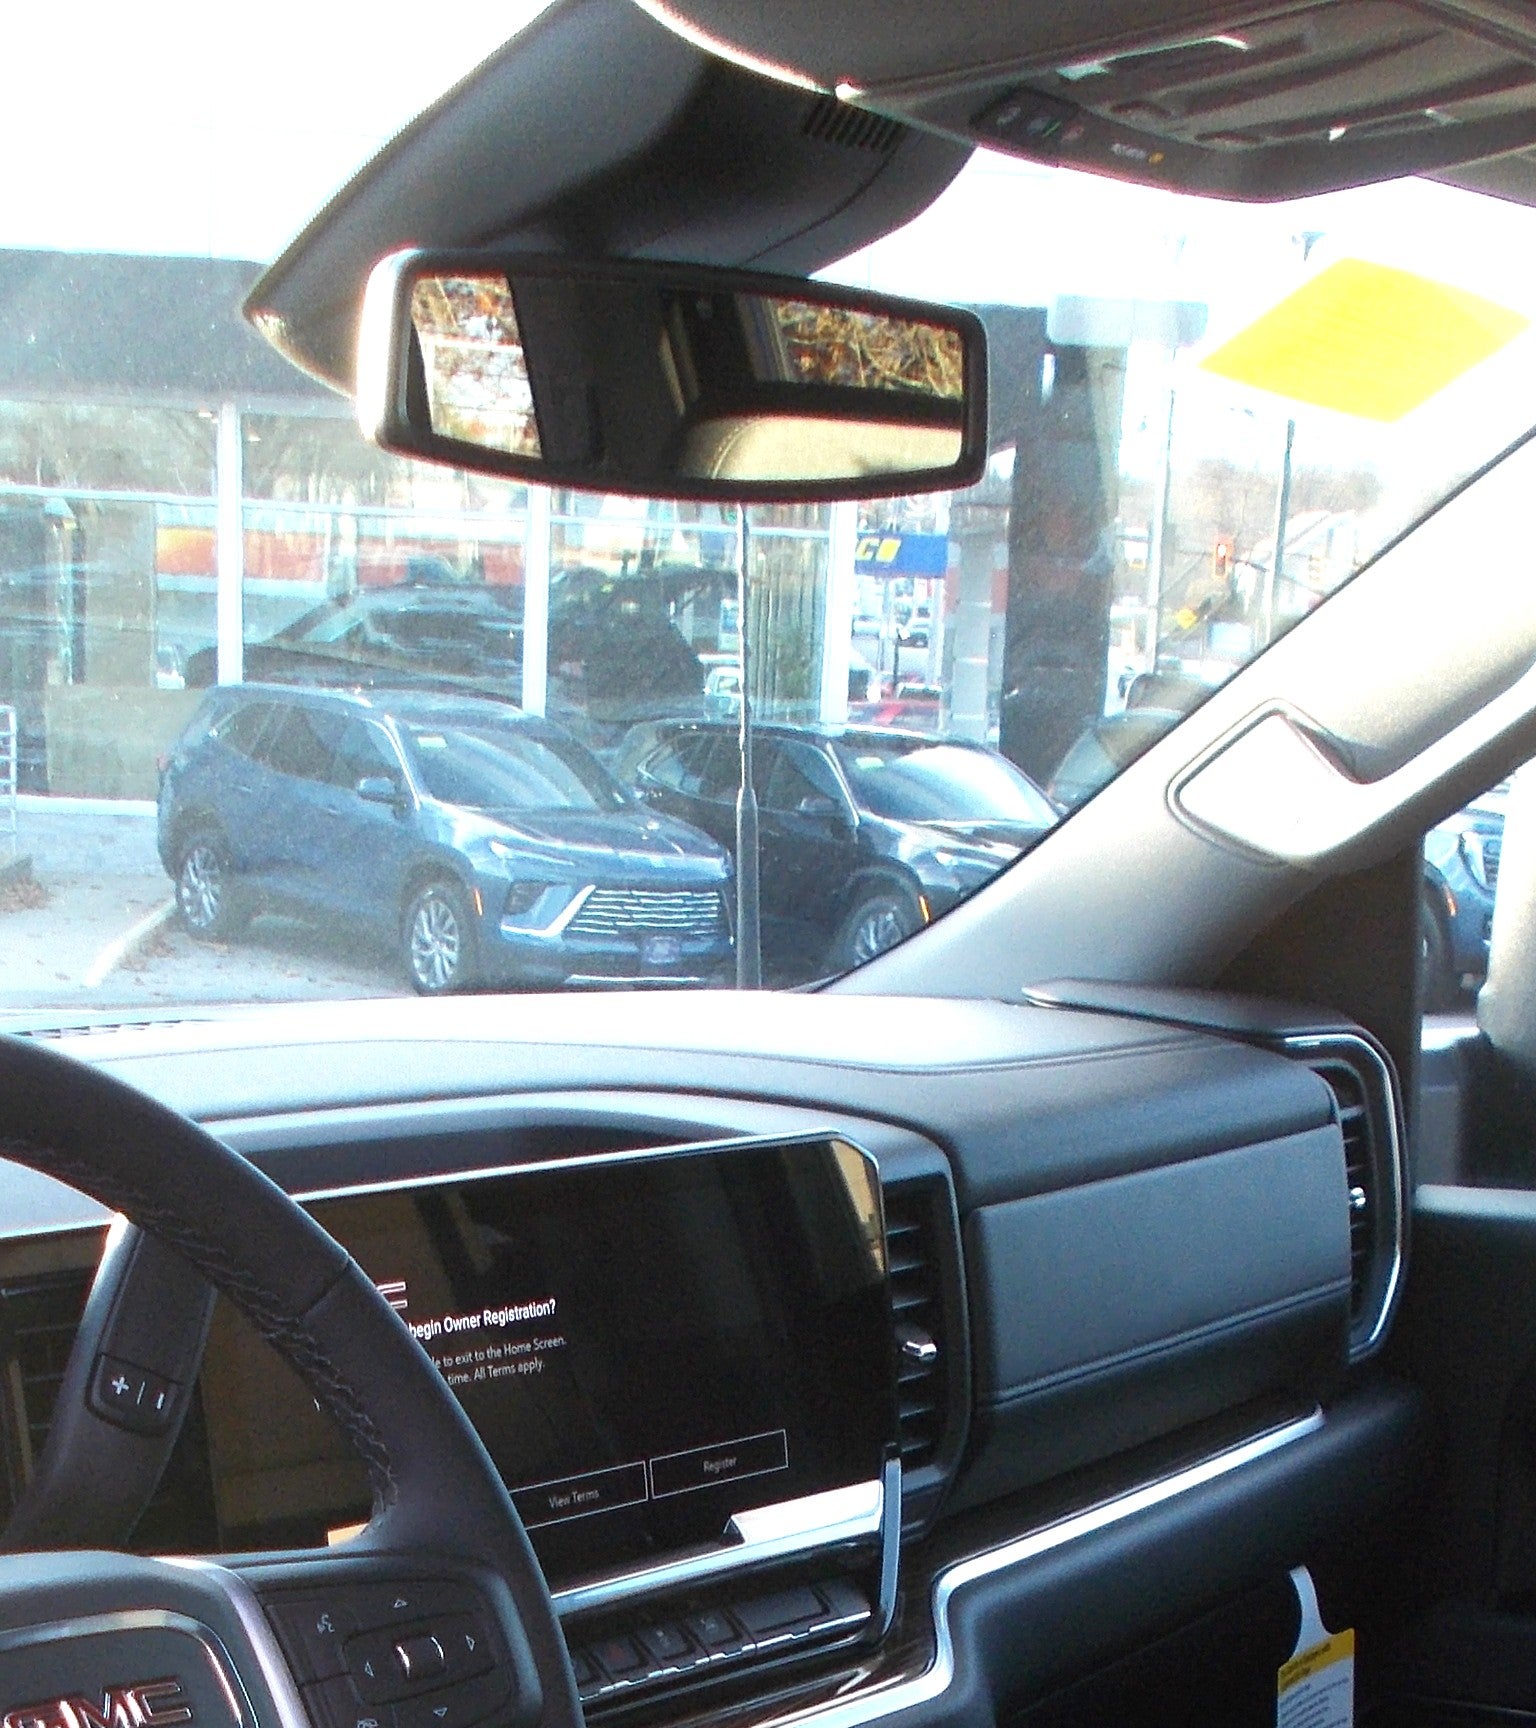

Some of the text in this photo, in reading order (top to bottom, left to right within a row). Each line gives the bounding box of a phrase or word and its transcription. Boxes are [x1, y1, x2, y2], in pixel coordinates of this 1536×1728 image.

[409, 1298, 556, 1341] begin Owner Registration?
[443, 1356, 454, 1368] to
[455, 1350, 472, 1366] exit
[474, 1350, 485, 1363] to
[486, 1345, 502, 1360] the
[503, 1342, 532, 1355] Home
[533, 1336, 567, 1352] Screen.
[474, 1367, 486, 1381] All
[487, 1363, 516, 1379] Terms
[517, 1357, 546, 1375] apply.
[702, 1456, 737, 1474] Register
[571, 1488, 600, 1505] Terms
